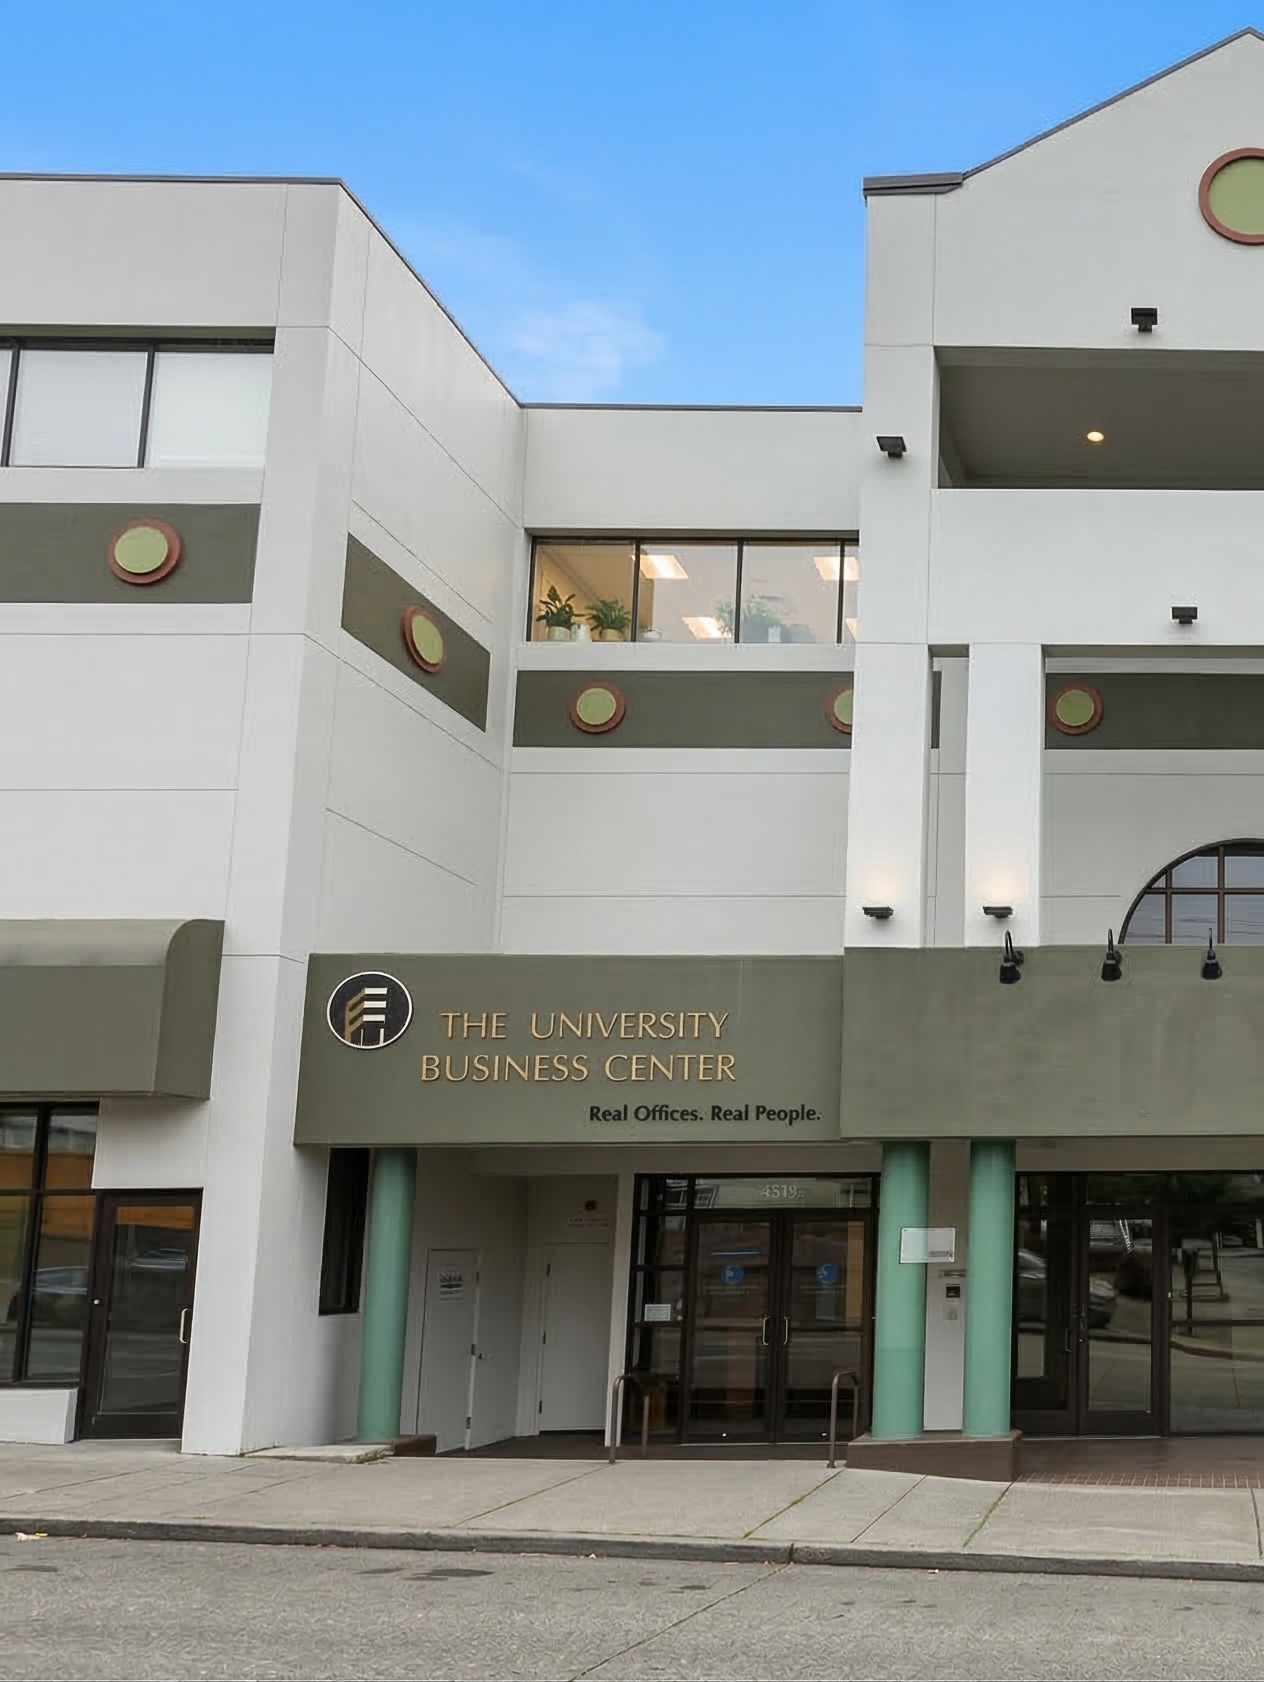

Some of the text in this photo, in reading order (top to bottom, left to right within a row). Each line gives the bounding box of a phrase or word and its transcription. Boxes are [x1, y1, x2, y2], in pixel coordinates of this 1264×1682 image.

[440, 1012, 729, 1039] THE UNIVERSITY
[421, 1054, 737, 1082] BUSINESS CENTER
[589, 1104, 821, 1126] Real Offices. Real People.
